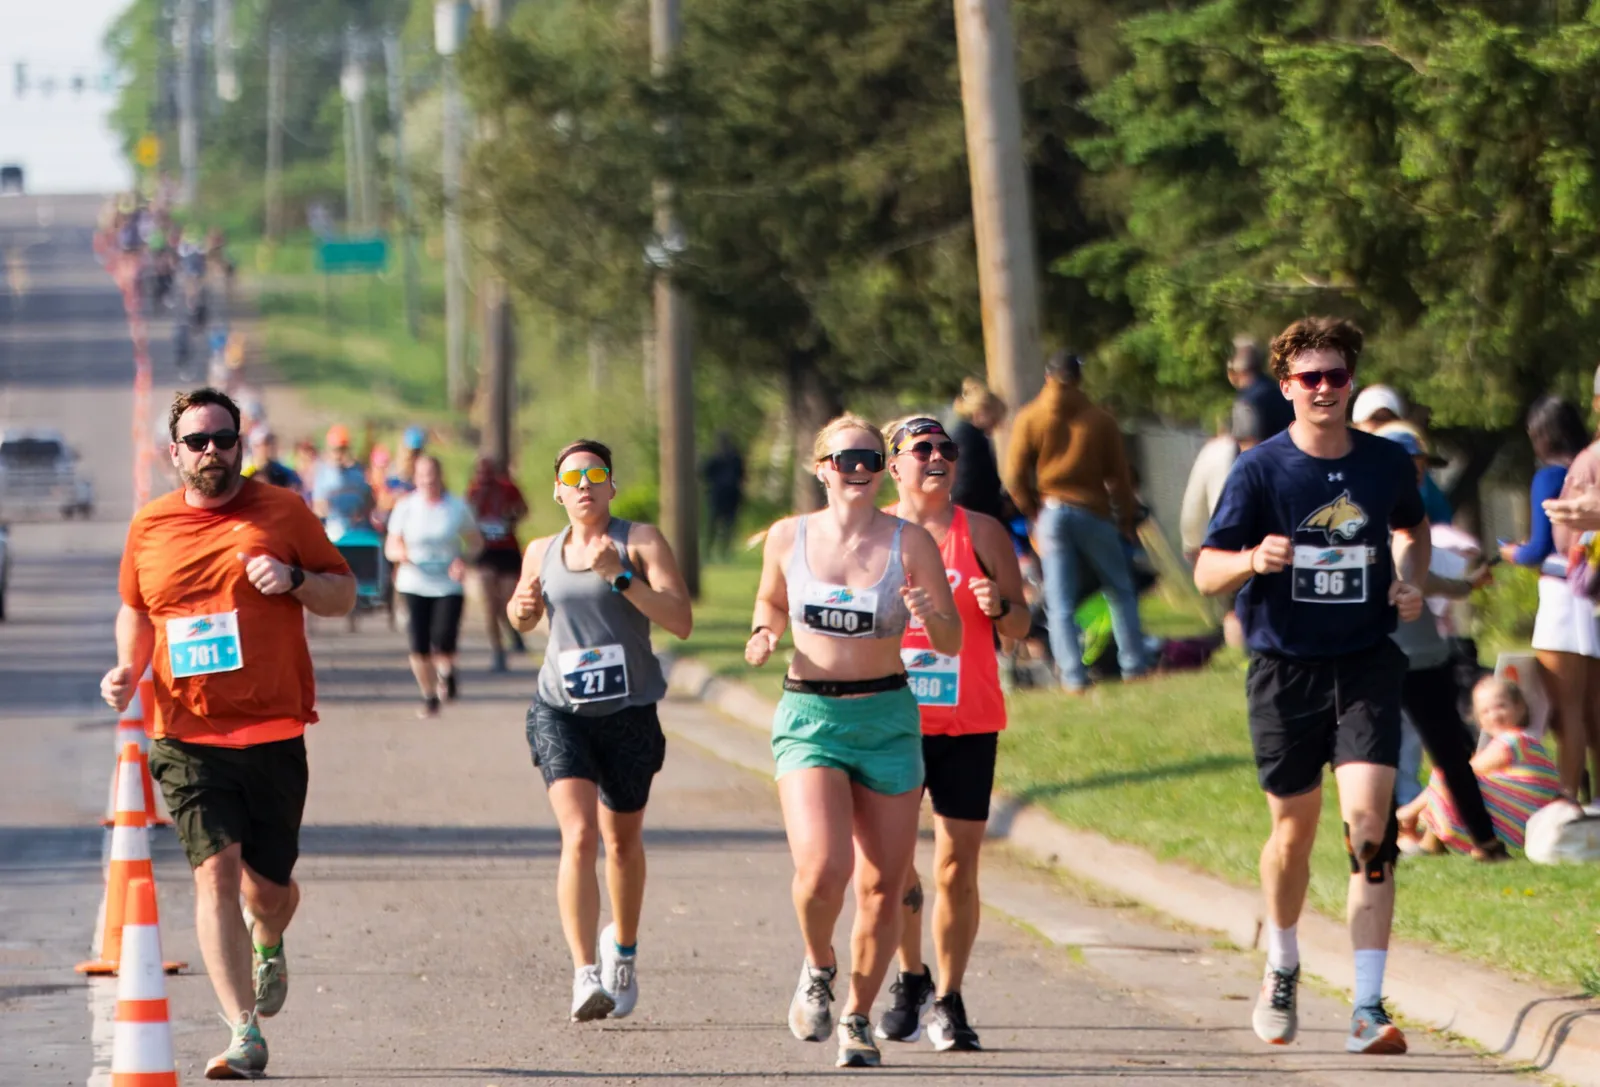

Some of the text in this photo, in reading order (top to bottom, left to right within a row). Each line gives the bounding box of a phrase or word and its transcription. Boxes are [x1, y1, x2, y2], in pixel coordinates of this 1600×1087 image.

[1314, 571, 1345, 595] 96
[818, 609, 858, 632] 100
[187, 643, 219, 668] 701
[581, 670, 605, 694] 27
